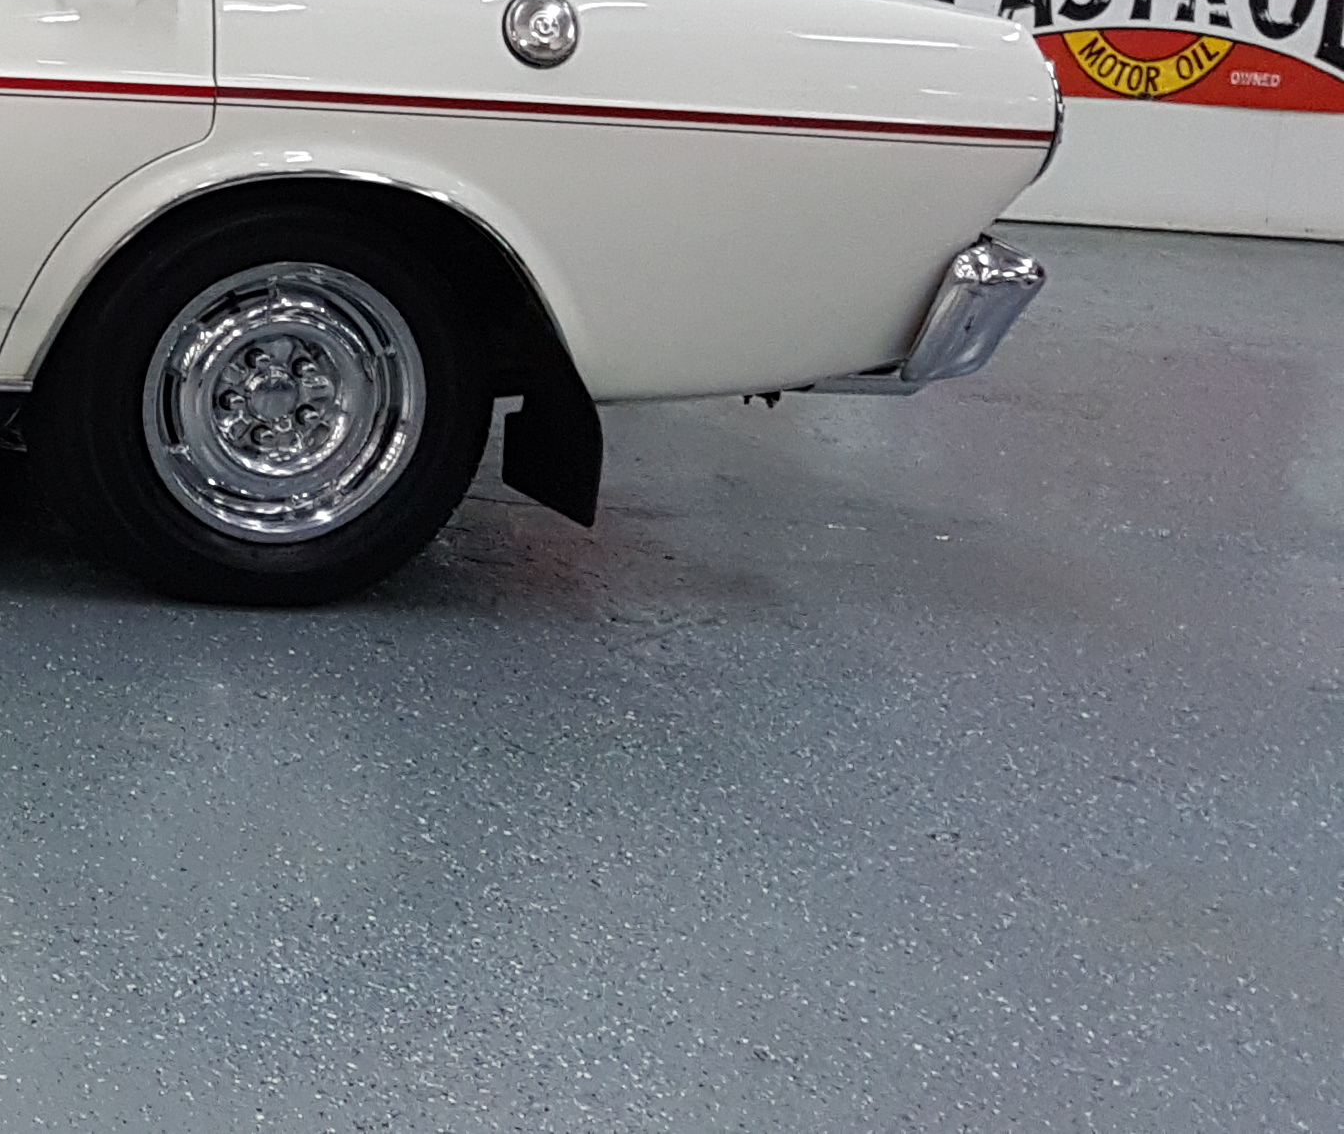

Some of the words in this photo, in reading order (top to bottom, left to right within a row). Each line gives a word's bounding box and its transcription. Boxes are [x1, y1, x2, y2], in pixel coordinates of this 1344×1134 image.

[1079, 36, 1161, 93] MOTOR
[1175, 41, 1220, 80] OIL
[1230, 71, 1282, 88] OWNED
